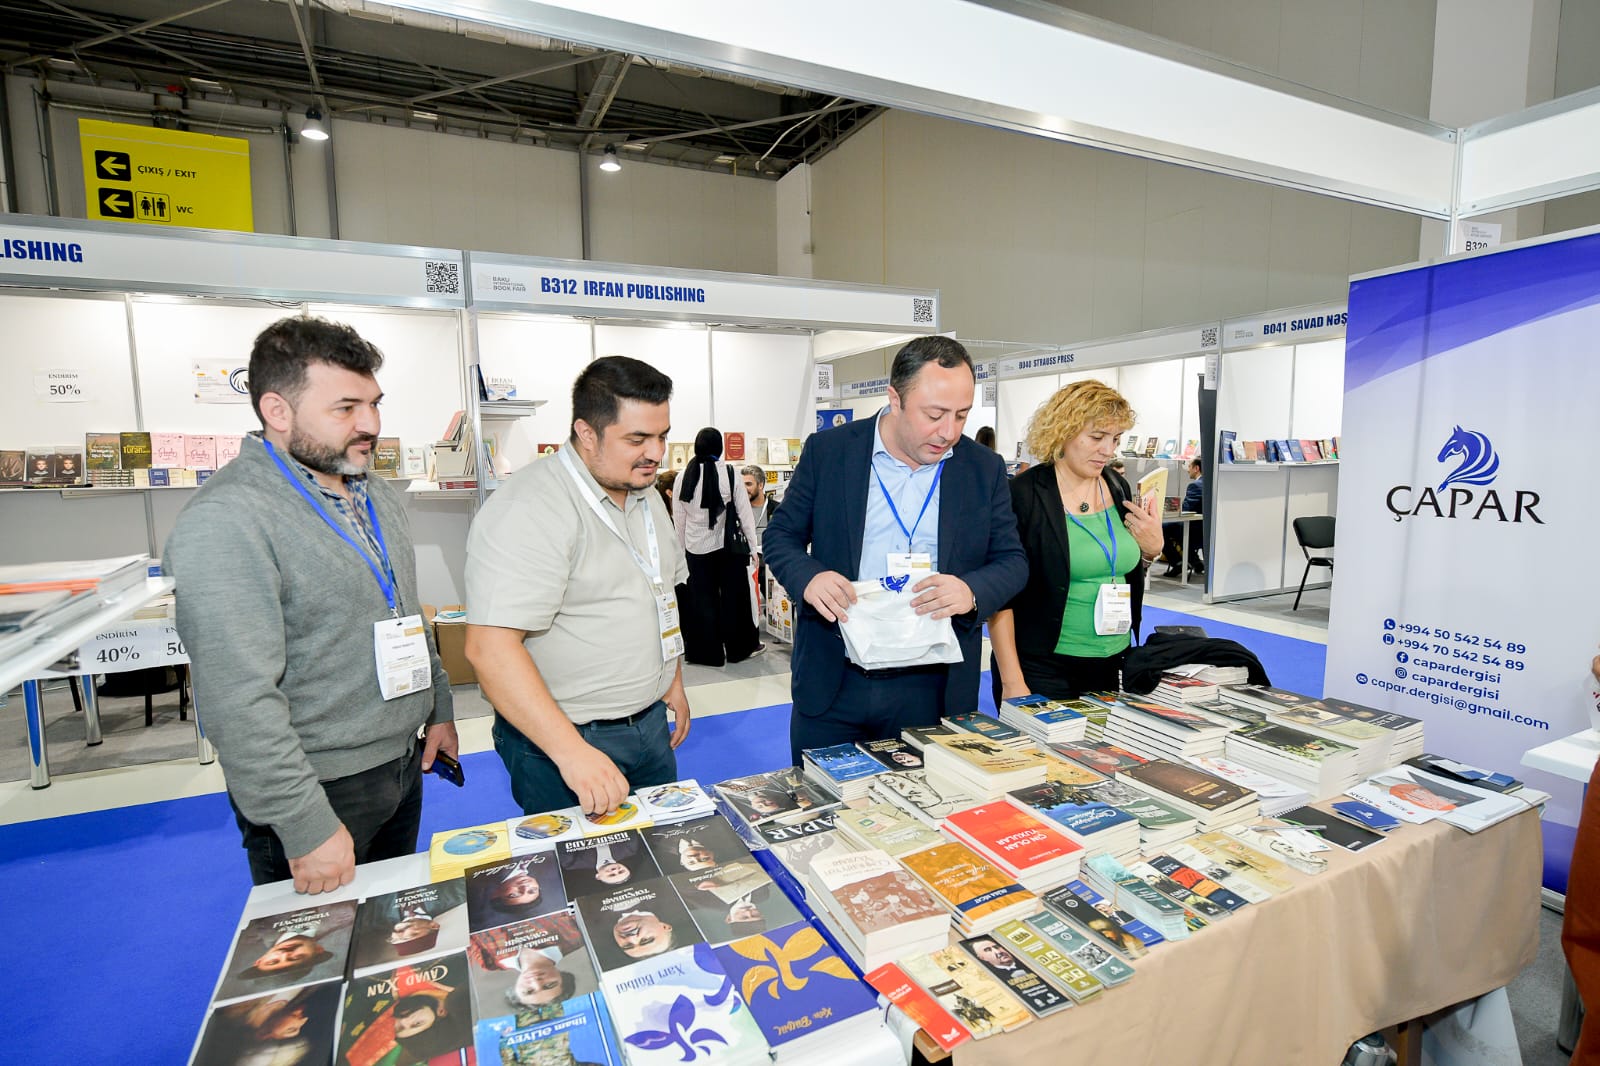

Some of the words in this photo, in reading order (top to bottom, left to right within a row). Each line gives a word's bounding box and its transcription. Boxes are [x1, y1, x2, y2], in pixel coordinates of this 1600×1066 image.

[138, 165, 164, 177] ÇIXIŞ
[175, 170, 198, 179] EXIT
[176, 205, 194, 214] WC
[541, 277, 577, 295] B312
[584, 281, 624, 298] IRFAN
[627, 284, 705, 303] PUBLISHING
[1263, 322, 1287, 335] B041
[1290, 316, 1324, 331] SAVAD
[1033, 357, 1057, 368] STRAUSS
[1057, 354, 1075, 367] PRESS
[50, 383, 81, 396] 50%
[1386, 485, 1546, 525] ÇAPAR
[1398, 622, 1431, 637] +994
[1434, 628, 1450, 640] 50
[1453, 632, 1480, 647] 542
[1483, 638, 1502, 651] 54
[1506, 642, 1526, 654] 89
[96, 644, 140, 664] 40%
[1397, 638, 1430, 653] +994
[1432, 644, 1449, 656] 70
[1452, 648, 1478, 662] 542
[1482, 654, 1501, 667] 54
[1505, 659, 1525, 671] 89
[1412, 656, 1501, 684] capardergisi
[1411, 672, 1500, 701] capardergisi
[1371, 676, 1549, 731] capar.dergisi@gmail.com
[766, 814, 838, 840] APAR
[405, 964, 448, 986] CAVAD
[367, 976, 399, 998] XAN
[506, 1027, 552, 1046] ƏLİYEV
